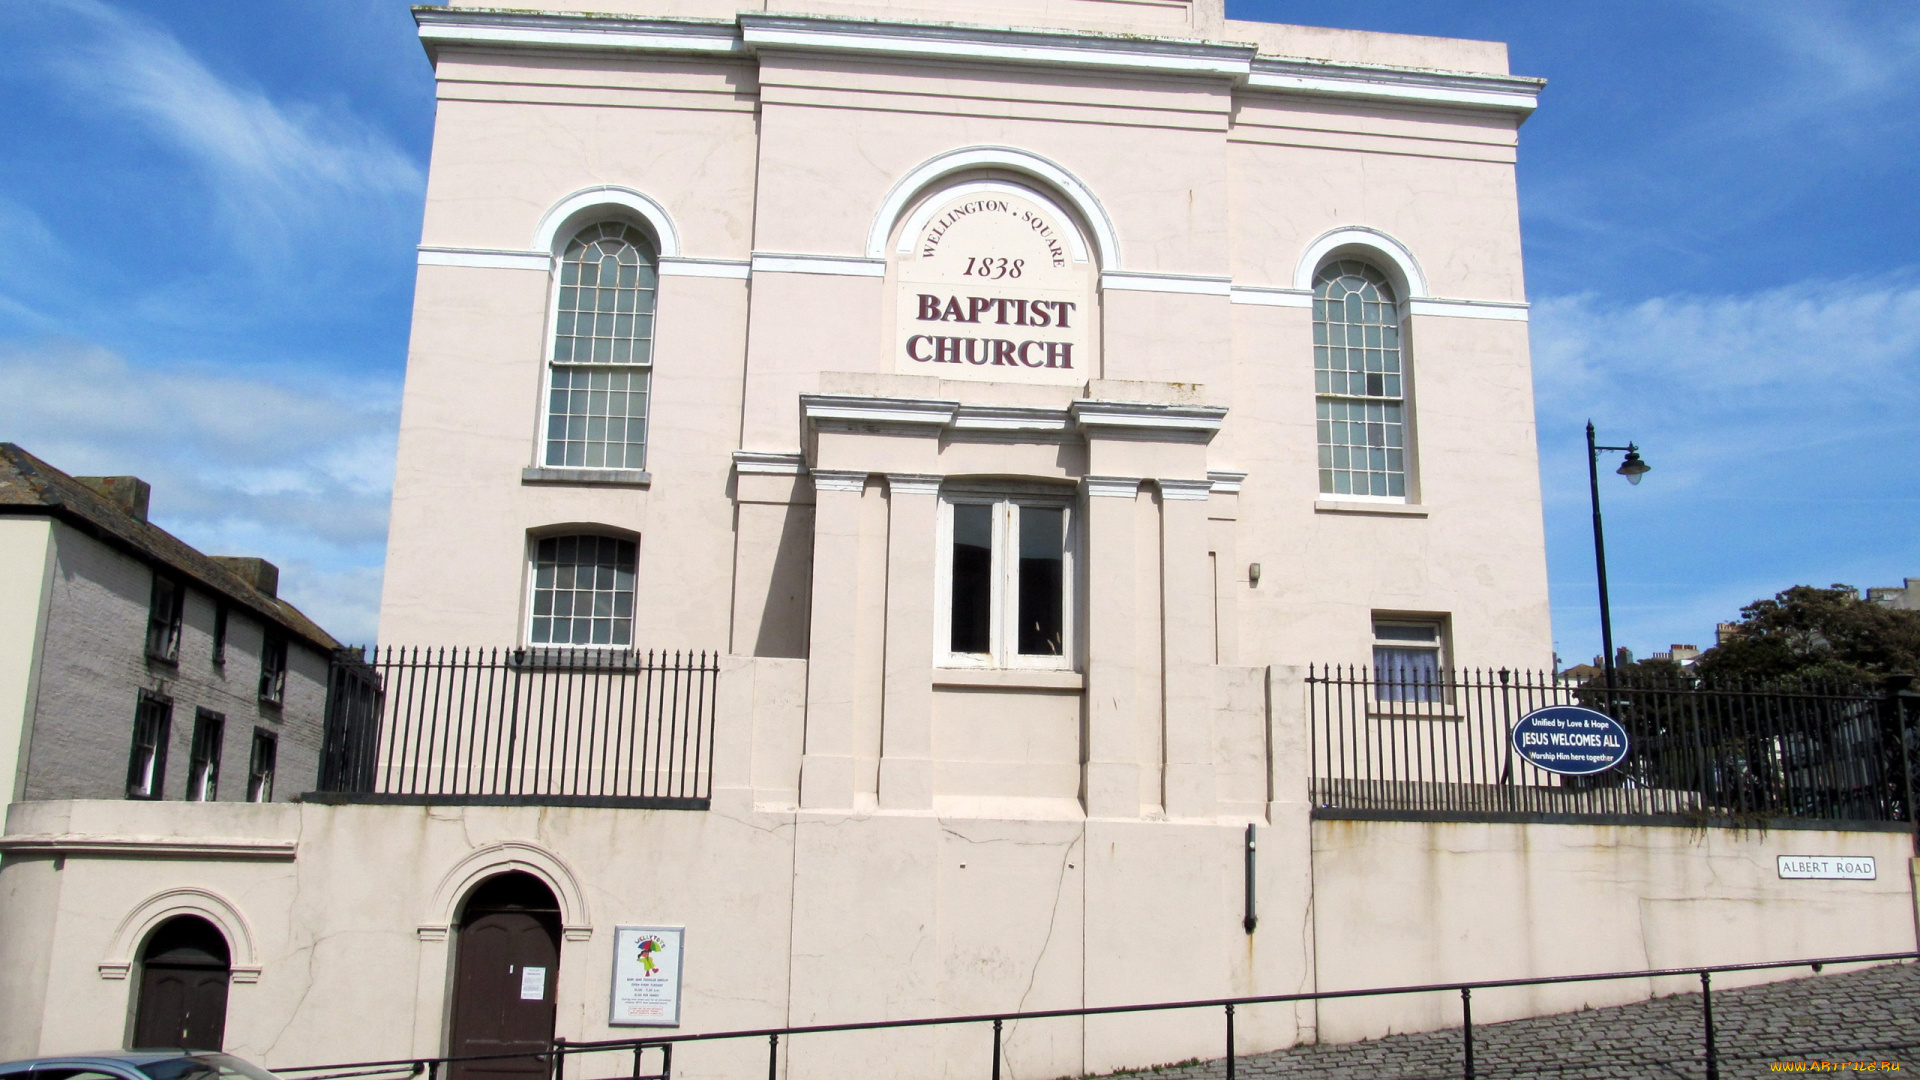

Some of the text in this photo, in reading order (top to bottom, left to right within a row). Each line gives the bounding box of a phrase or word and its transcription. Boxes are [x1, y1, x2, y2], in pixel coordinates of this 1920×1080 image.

[923, 200, 1065, 268] WELLINGTON SQUARE
[963, 257, 1025, 280] 1838
[915, 294, 1076, 328] BAPTIST
[906, 334, 1074, 369] CHURCH
[1531, 718, 1609, 730] Unified by Love & Hope
[1522, 732, 1620, 747] JESUS WELCOMES ALL
[1529, 751, 1614, 763] Worship Him here together
[1783, 862, 1872, 873] ALBERT ROAD
